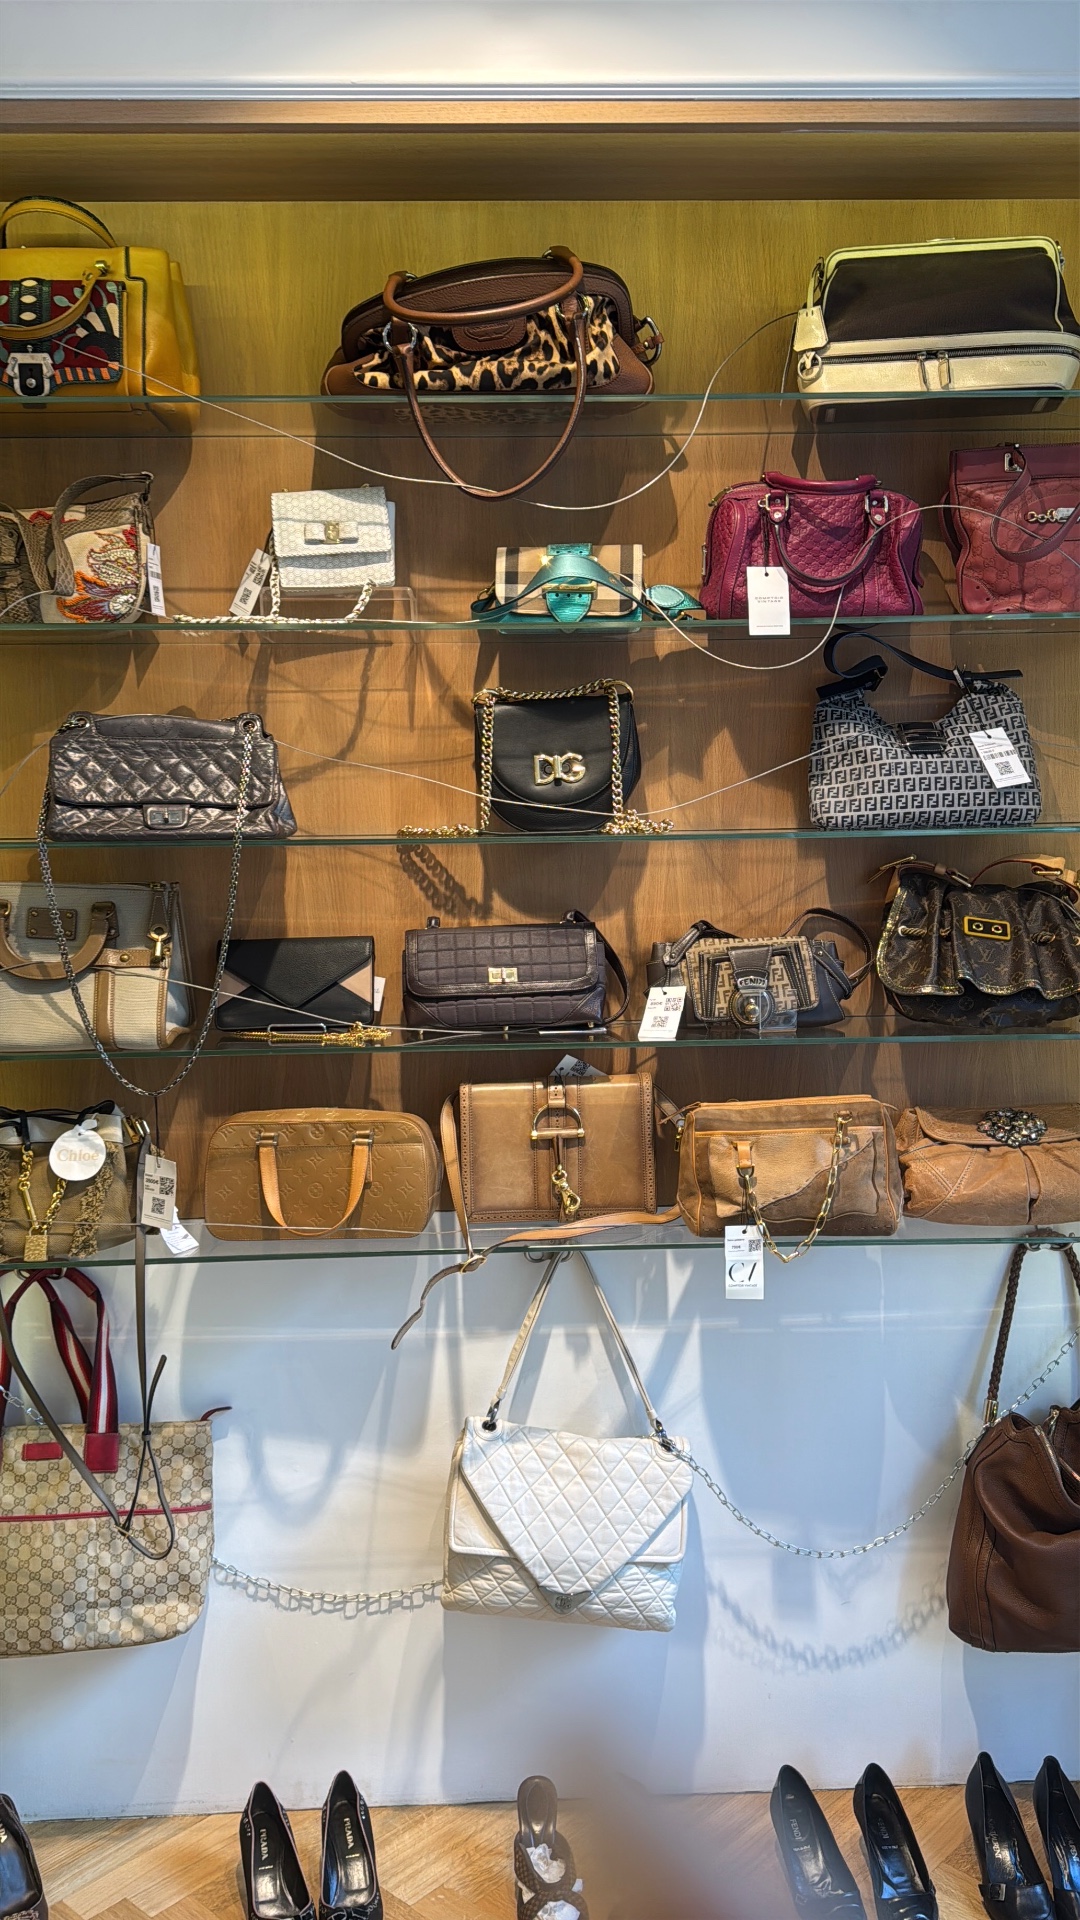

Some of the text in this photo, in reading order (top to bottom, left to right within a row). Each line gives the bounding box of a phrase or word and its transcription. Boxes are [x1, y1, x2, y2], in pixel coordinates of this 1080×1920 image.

[57, 1148, 100, 1162] Chloé
[344, 1817, 355, 1850] PRADA
[789, 1818, 803, 1840] FENDI
[259, 1828, 269, 1861] PRADA
